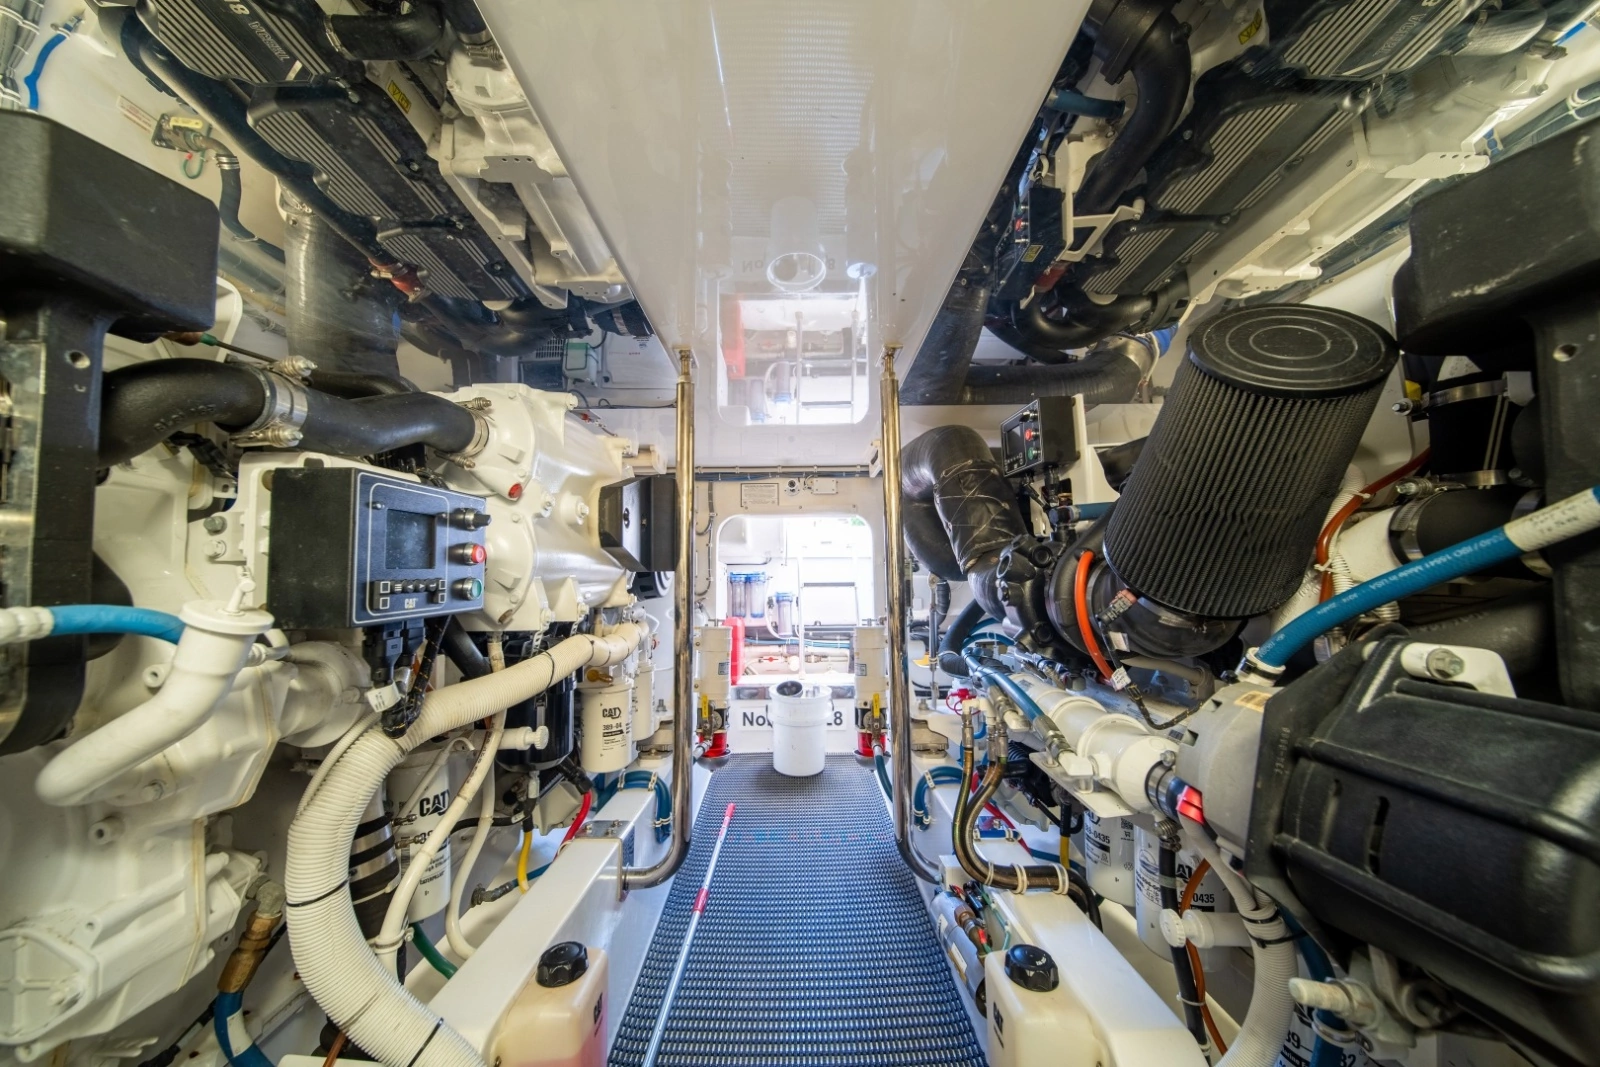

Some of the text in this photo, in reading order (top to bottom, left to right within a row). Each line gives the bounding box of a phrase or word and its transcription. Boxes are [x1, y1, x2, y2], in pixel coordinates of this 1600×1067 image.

[405, 598, 417, 610] CAT
[602, 707, 621, 720] CAT
[419, 789, 451, 817] CAT
